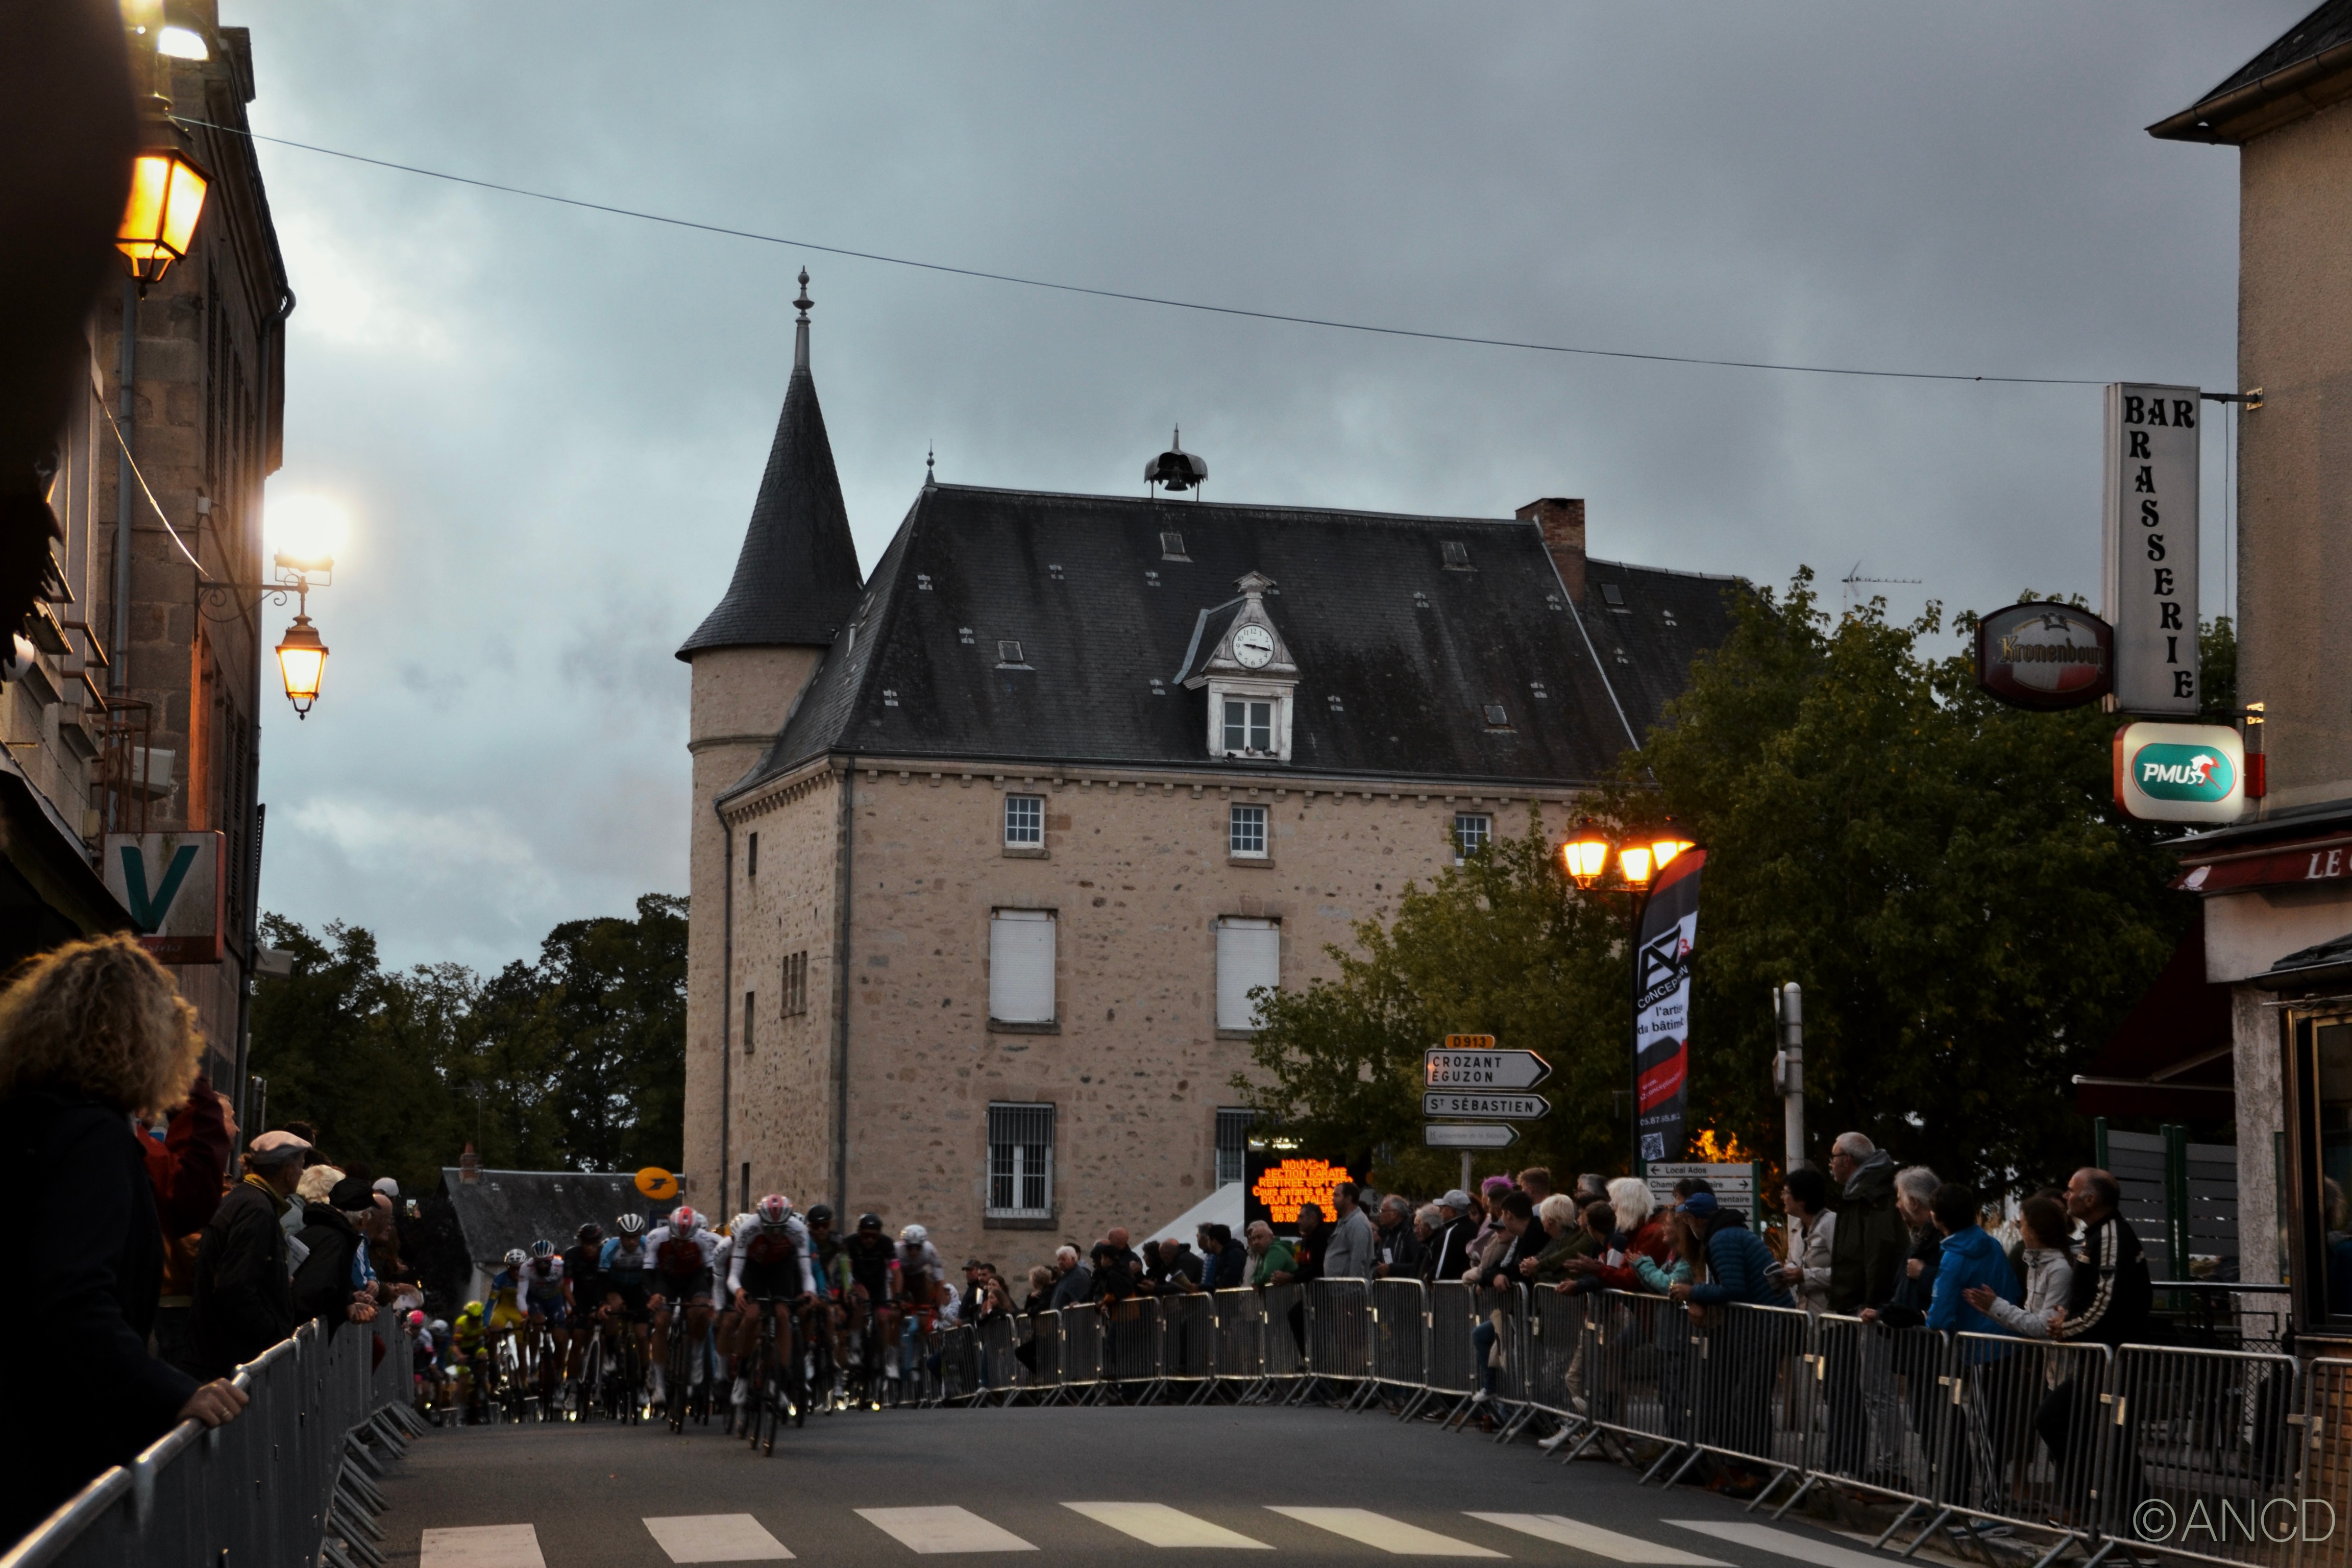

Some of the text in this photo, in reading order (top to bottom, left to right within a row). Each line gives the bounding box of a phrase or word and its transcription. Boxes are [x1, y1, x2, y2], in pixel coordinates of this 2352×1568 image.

[2124, 396, 2194, 428] BAR
[1999, 636, 2106, 674] Kronenbourg
[2143, 762, 2191, 784] PMU
[2304, 849, 2342, 879] LE
[1638, 1024, 1648, 1035] du
[1432, 1057, 1502, 1067] CROZANT
[1432, 1069, 1493, 1083] ÉGUZON
[1452, 1097, 1533, 1113] SÉBASTIEN
[1282, 1159, 1329, 1169] NOUVEAU
[1265, 1168, 1346, 1179] SECTION KARATE
[1259, 1179, 1305, 1188] RENTREE
[1306, 1179, 1329, 1188] SEPT
[1252, 1186, 1278, 1196] Cours
[1280, 1187, 1313, 1196] enfants
[1314, 1187, 1326, 1196] et
[1260, 1195, 1334, 1205] DOJO LA PALES
